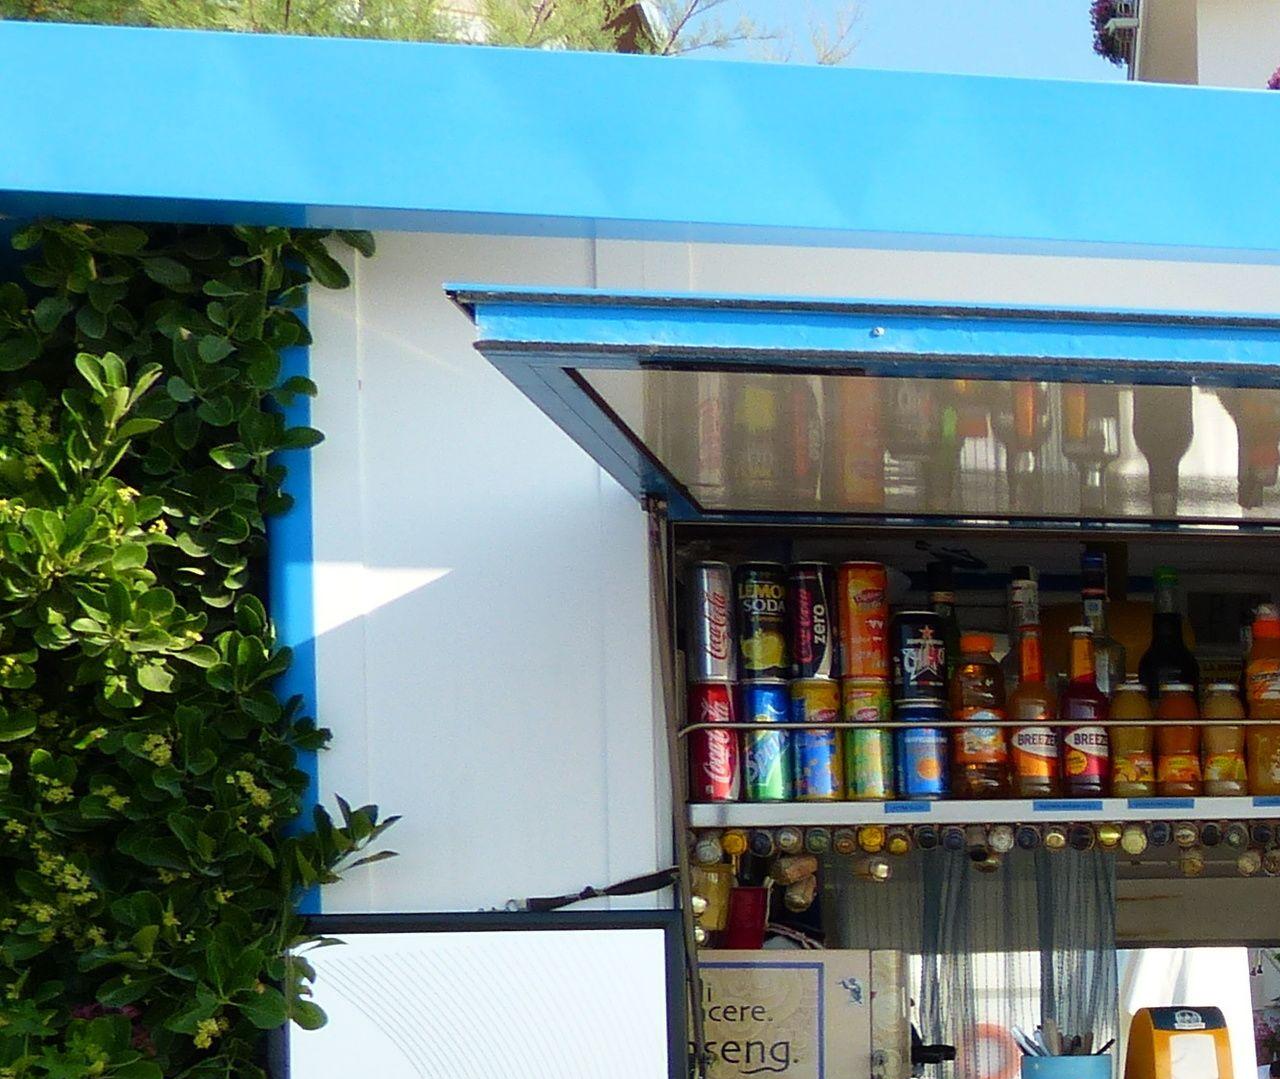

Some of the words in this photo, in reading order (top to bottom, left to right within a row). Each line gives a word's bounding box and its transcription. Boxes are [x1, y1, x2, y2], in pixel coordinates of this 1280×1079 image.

[738, 583, 785, 600] LEMO
[743, 600, 786, 613] SODA
[813, 604, 826, 645] zero
[1018, 734, 1057, 747] BREEZE
[707, 1004, 774, 1022] cere.
